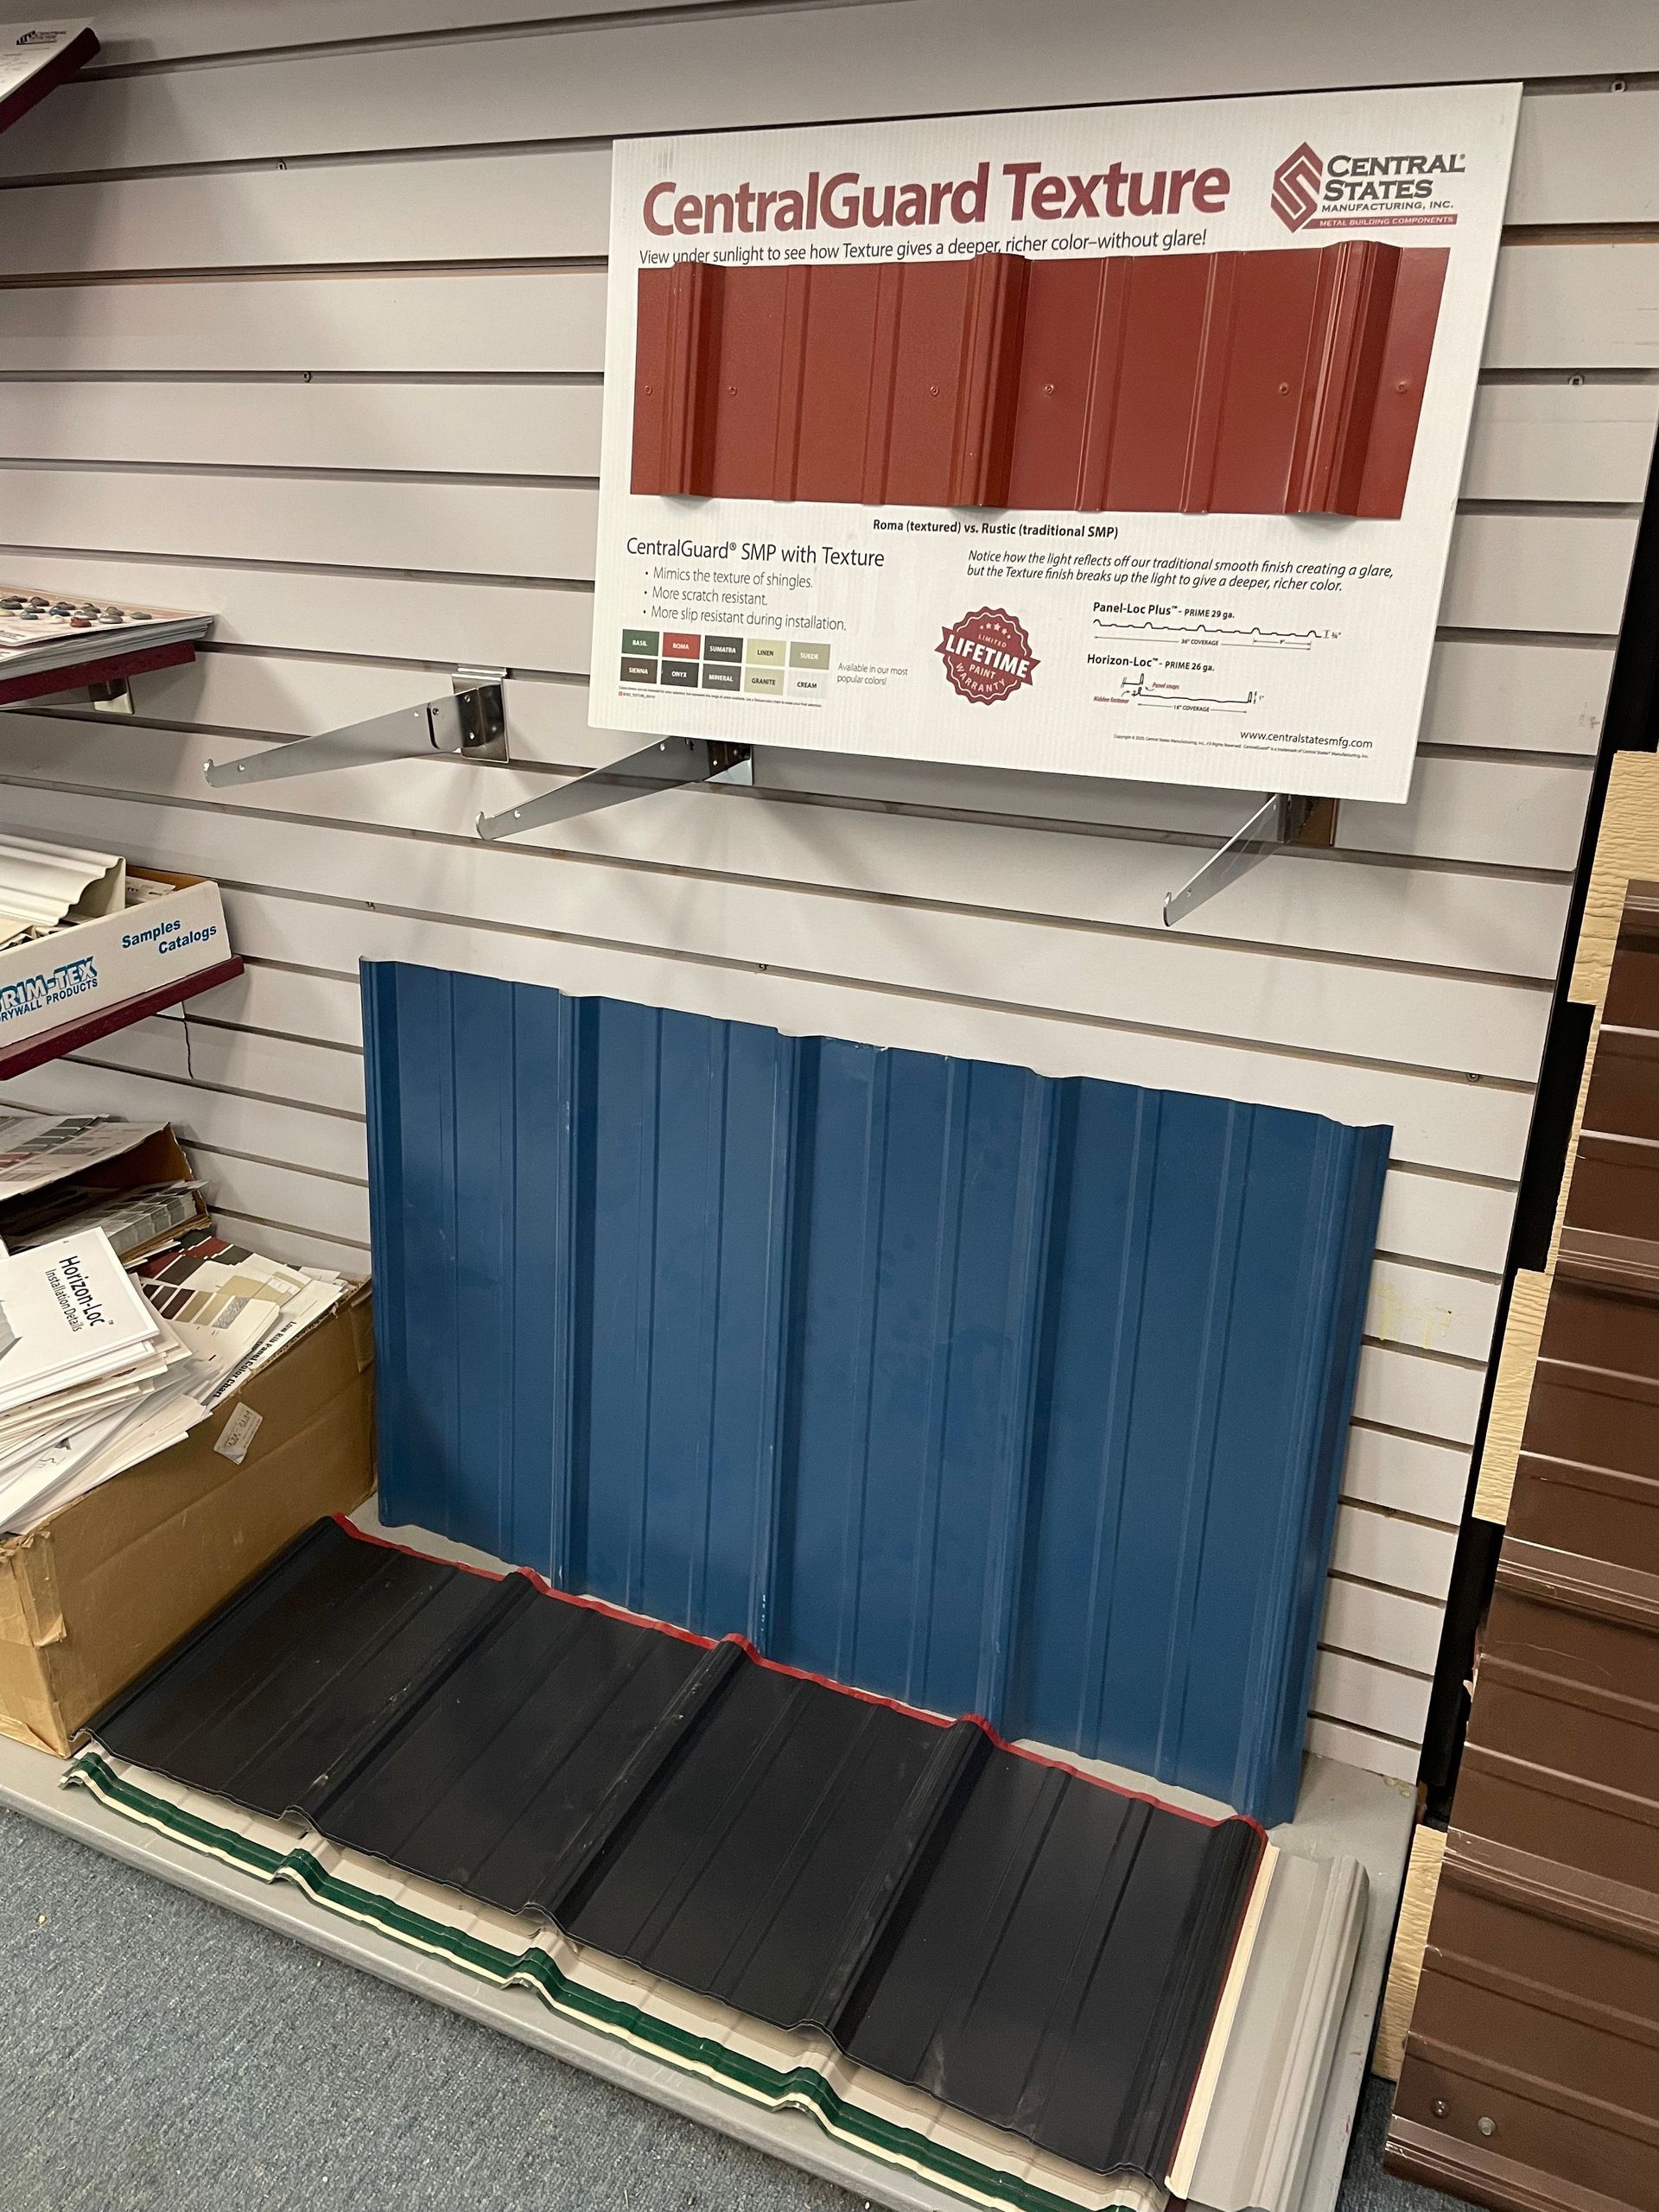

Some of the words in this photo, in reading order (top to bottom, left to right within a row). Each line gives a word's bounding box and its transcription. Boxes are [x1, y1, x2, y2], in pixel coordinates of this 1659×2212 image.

[642, 162, 991, 236] CentralGuard
[1002, 162, 1230, 221] Texture
[1323, 179, 1433, 201] STATES
[1321, 202, 1426, 213] MANUFACTURING,
[1429, 200, 1453, 209] INC.
[1319, 219, 1347, 227] METAL
[1392, 216, 1453, 225] COMPONENTS
[639, 249, 670, 264] View
[673, 248, 710, 263] under
[713, 246, 766, 264] sunlight
[767, 246, 781, 261] to
[784, 247, 806, 260] see
[810, 244, 839, 259] how
[843, 243, 893, 258] Texture
[897, 241, 932, 260] gives
[936, 243, 944, 255] a
[948, 238, 1001, 255] deeper,
[1006, 235, 1048, 252] richer
[1162, 229, 1207, 251] glare!
[873, 519, 904, 531] Roma
[906, 520, 961, 534] (textured)
[963, 524, 979, 534] vs.
[982, 523, 1017, 535] Rustic
[1019, 524, 1085, 537] (traditional
[1087, 526, 1118, 539] SMP)
[741, 543, 777, 561] SMP
[781, 545, 817, 563] with
[822, 546, 885, 567] Texture
[968, 550, 1001, 563] Notice
[1002, 551, 1027, 563] how
[1028, 552, 1046, 564] the
[1047, 552, 1072, 568] light
[1073, 554, 1111, 567] reflects
[1114, 555, 1131, 568] off
[1131, 558, 1151, 568] our
[1153, 557, 1213, 570] traditional
[1214, 560, 1259, 572] smooth
[1262, 561, 1293, 574] finish
[1295, 563, 1346, 578] creating
[1348, 566, 1357, 575] a
[1359, 564, 1394, 579] glare,
[653, 566, 690, 581] Mimics
[693, 569, 710, 582] the
[713, 571, 751, 584] texture
[753, 572, 766, 585] of
[766, 572, 813, 590] shingles.
[967, 564, 986, 576] but
[987, 565, 1003, 577] the
[1006, 566, 1043, 578] Texture
[1046, 568, 1074, 581] finish
[1076, 569, 1111, 582] breaks
[1114, 573, 1128, 585] up
[1131, 571, 1148, 584] the
[1150, 572, 1178, 587] light
[1179, 575, 1191, 586] to
[1192, 575, 1217, 588] give
[1218, 578, 1227, 588] a
[1229, 575, 1271, 590] deeper,
[1273, 578, 1308, 589] richer
[1310, 578, 1343, 592] color.
[652, 586, 679, 600] More
[682, 589, 719, 602] scratch
[721, 591, 768, 606] resistant.
[652, 605, 678, 619] More
[680, 607, 698, 622] slip
[701, 610, 744, 624] resistant
[747, 612, 782, 630] during
[785, 614, 847, 631] installation.
[1093, 602, 1146, 614] Panel-Loc
[1184, 608, 1210, 618] PRIME
[1223, 612, 1235, 620] ga.
[632, 639, 647, 647] BASIL
[709, 645, 736, 654] SUMATRA
[978, 633, 1007, 648] LIMITED
[945, 633, 1030, 678] LIFETIME
[1165, 660, 1190, 670] PRIME
[628, 666, 648, 675] SIENNA
[671, 670, 687, 678] ONYX
[838, 662, 868, 672] Available
[869, 664, 876, 673] in
[956, 662, 1006, 692] WARRANTY
[969, 664, 996, 679] PAINT
[709, 674, 734, 683] MINERAL
[751, 677, 776, 686] GRANITE
[797, 681, 817, 690] CREAM
[836, 675, 863, 683] popular
[1240, 731, 1373, 748] www.centralstatesmfg.com
[122, 920, 181, 949] Samples
[159, 925, 217, 954] Catalogs
[0, 956, 98, 1012] RIM-TEX
[0, 1000, 42, 1022] RYWALL
[46, 978, 98, 1005] PRODUCTS
[45, 1268, 70, 1310] Installation
[63, 1307, 84, 1332] Details
[281, 1320, 297, 1333] Low
[252, 1342, 273, 1362] Panel
[234, 1357, 254, 1380] Color
